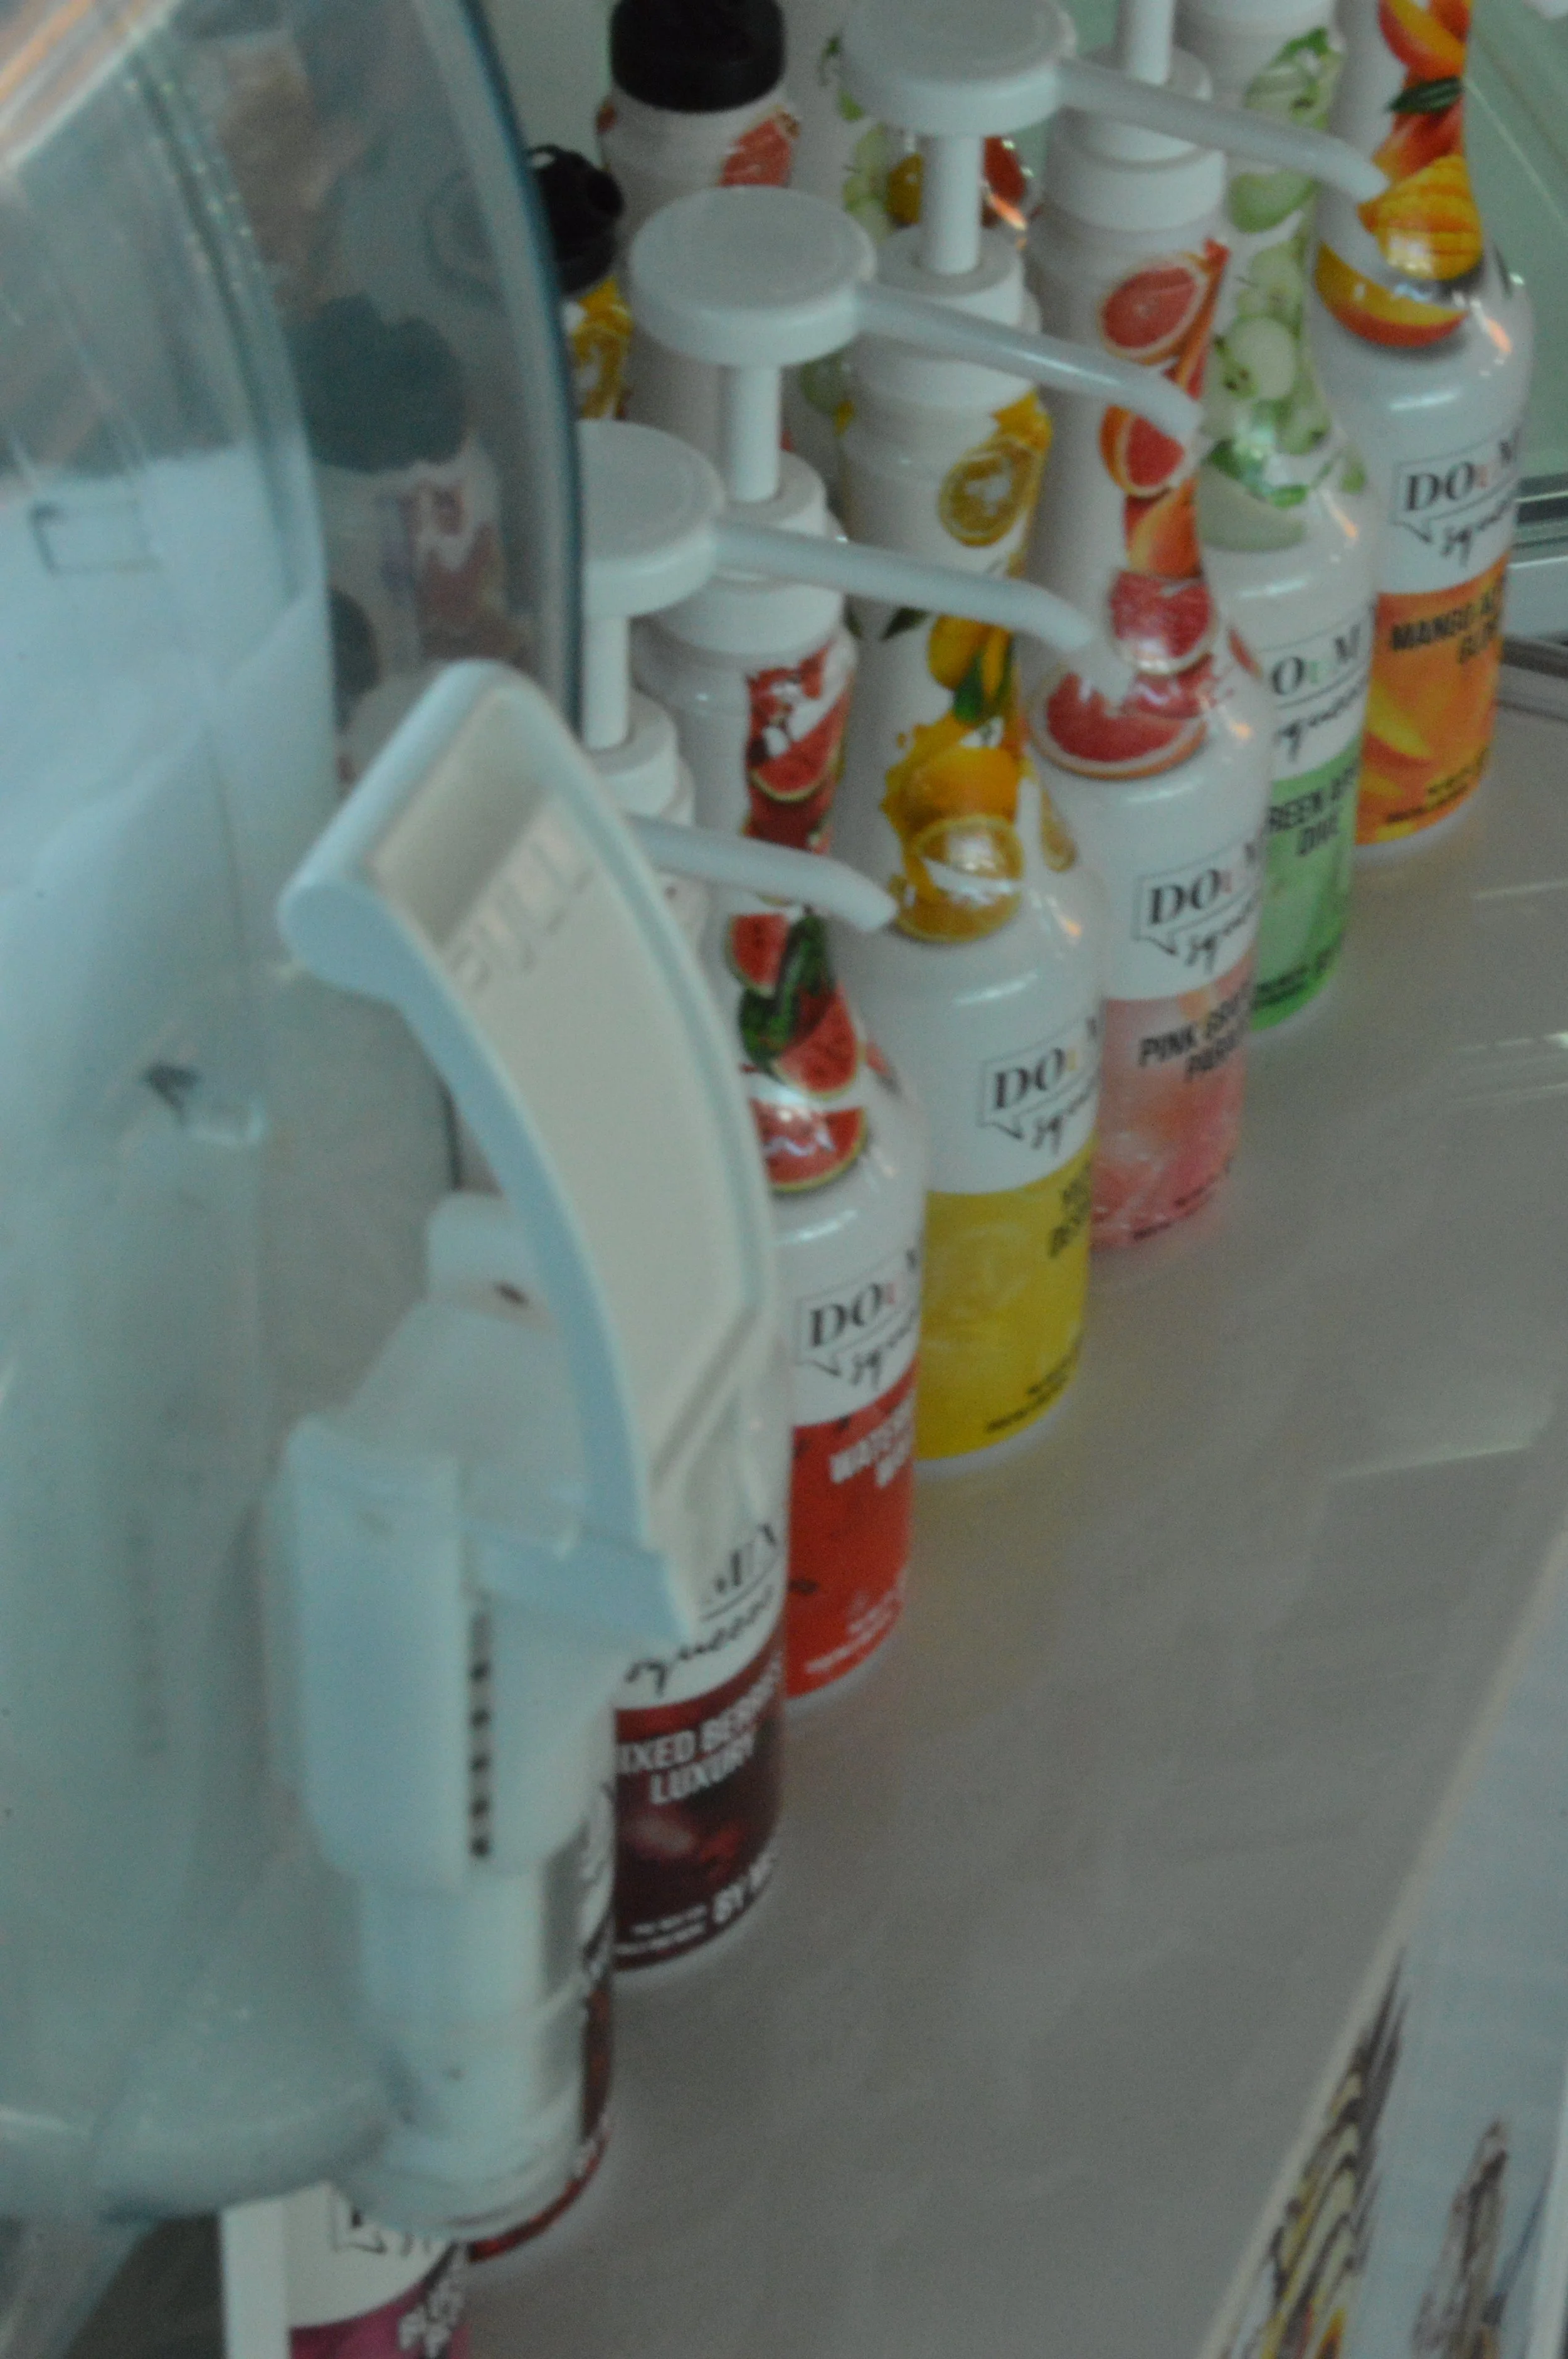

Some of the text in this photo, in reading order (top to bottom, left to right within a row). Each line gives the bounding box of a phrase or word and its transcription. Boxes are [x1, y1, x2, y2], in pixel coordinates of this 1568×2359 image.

[1139, 1026, 1198, 1068] PINK
[617, 1729, 696, 1777] IXED
[649, 1730, 758, 1808] LUXURY
